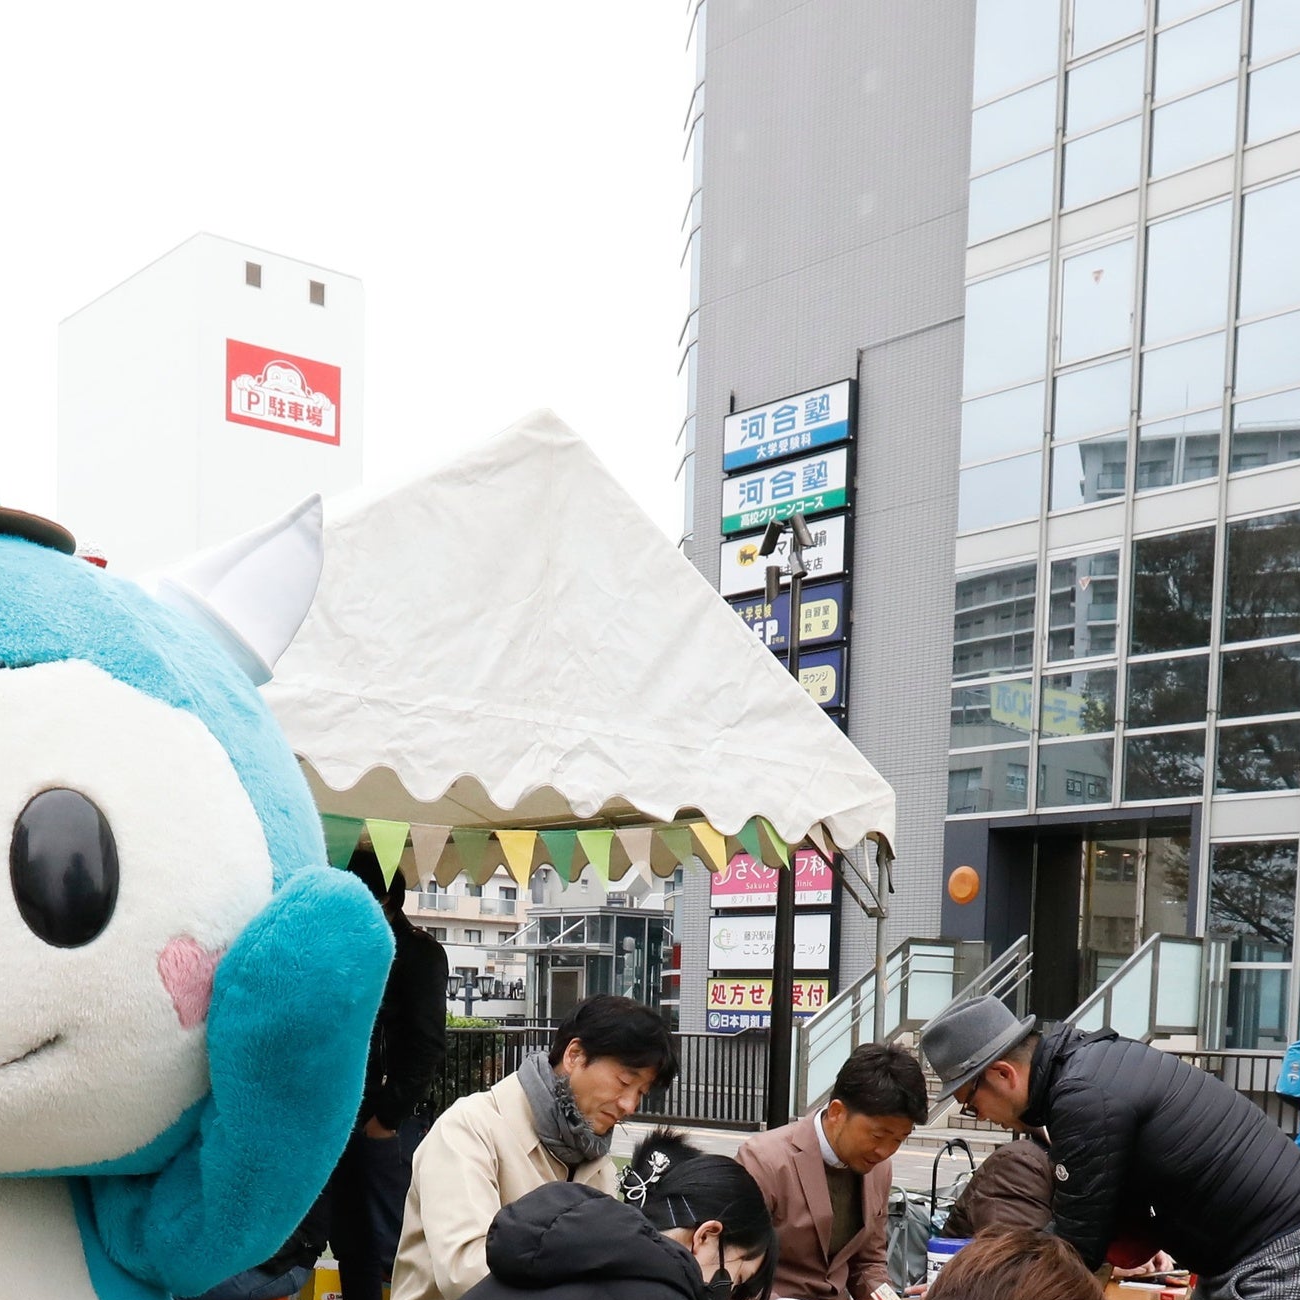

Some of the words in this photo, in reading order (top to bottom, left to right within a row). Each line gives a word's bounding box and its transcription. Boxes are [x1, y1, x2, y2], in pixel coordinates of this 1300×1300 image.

[268, 395, 323, 427] 駐車場
[740, 393, 831, 445] 河合塾
[756, 433, 813, 459] 大学受験科
[738, 459, 829, 508] 河合塾
[802, 670, 829, 685] ラウンジ
[735, 855, 827, 881] さくらフ科
[745, 881, 770, 890] Sakura
[797, 880, 813, 889] linic
[742, 942, 827, 956] こころのニック
[710, 983, 825, 1007] 処方せ受付
[721, 1014, 760, 1029] 日本調剤
